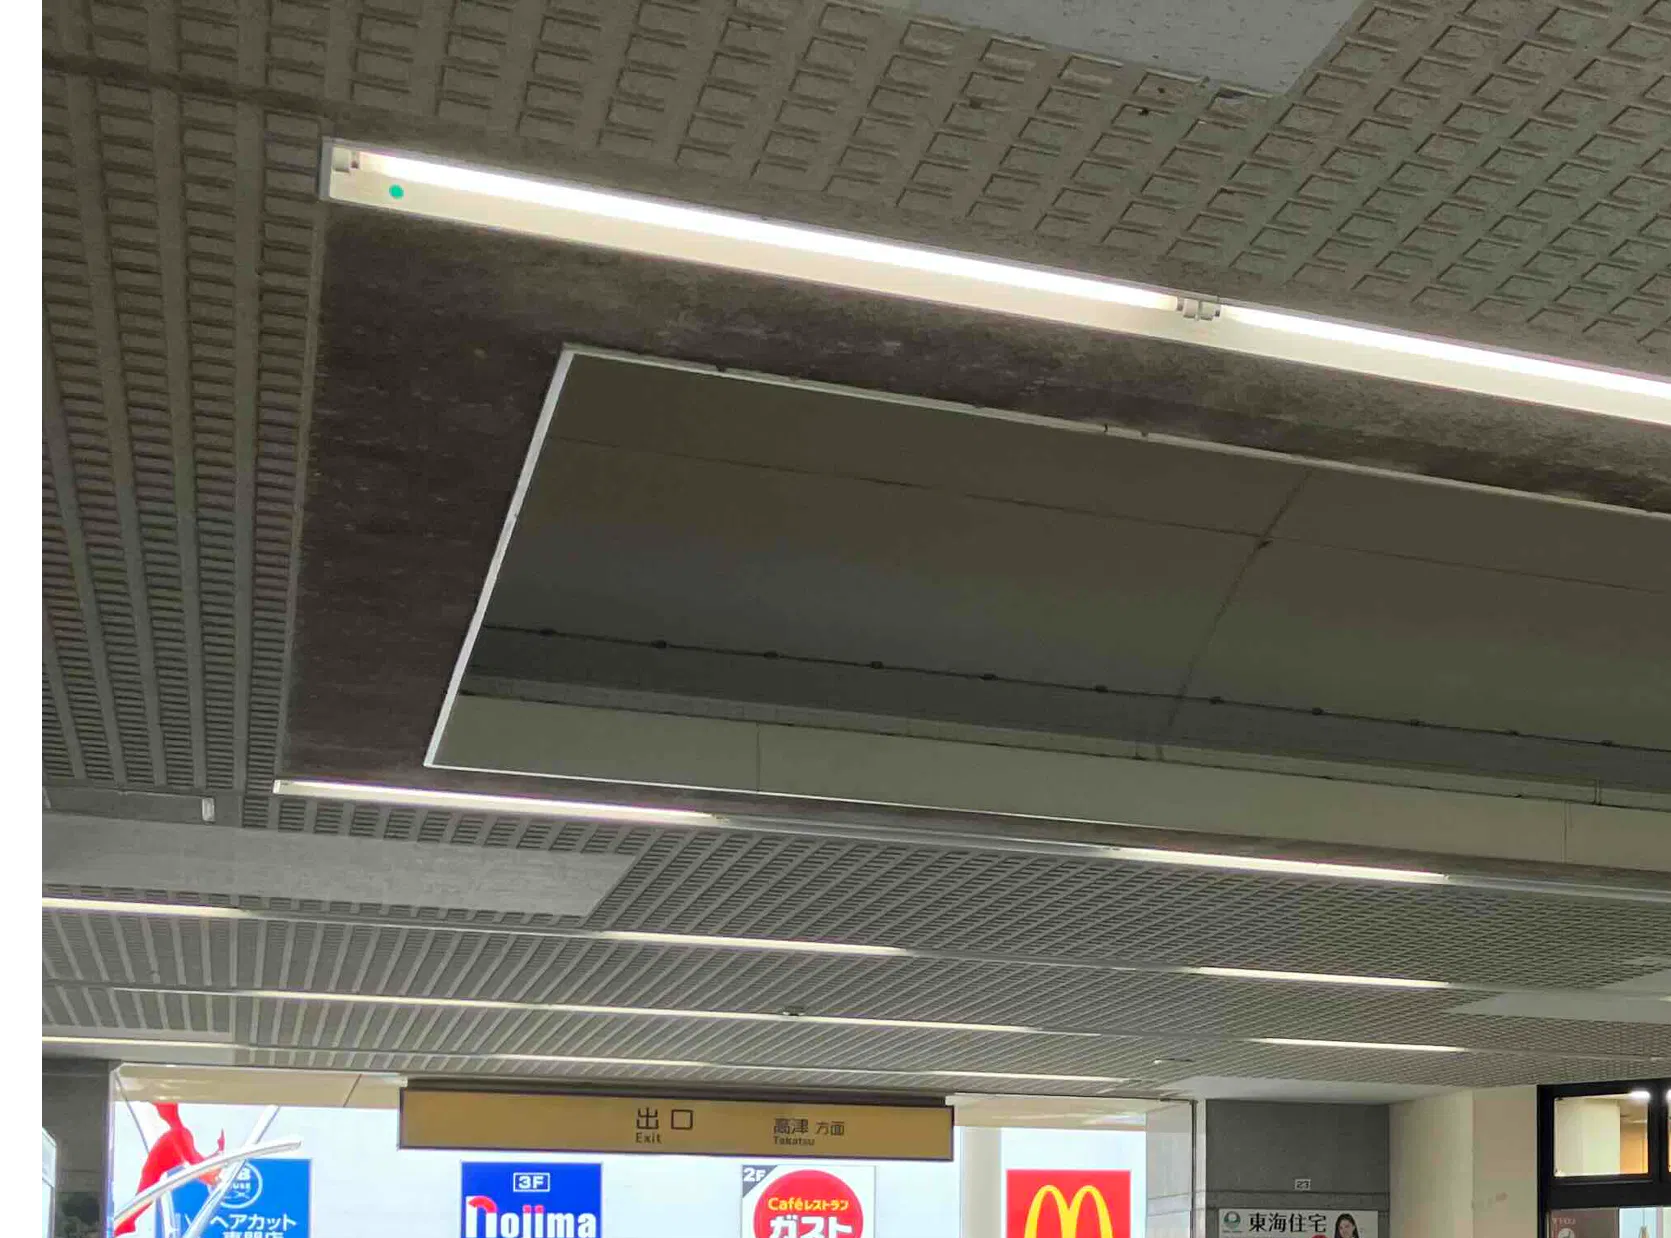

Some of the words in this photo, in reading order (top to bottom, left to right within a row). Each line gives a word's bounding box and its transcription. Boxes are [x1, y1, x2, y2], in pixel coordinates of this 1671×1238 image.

[636, 1106, 694, 1131] 出口
[635, 1131, 663, 1144] Exit
[773, 1135, 816, 1146] Takatsu
[743, 1167, 767, 1182] 2F
[518, 1175, 545, 1190] 3F
[210, 1213, 297, 1232] ヘアカット
[1248, 1212, 1328, 1233] 東海住宅
